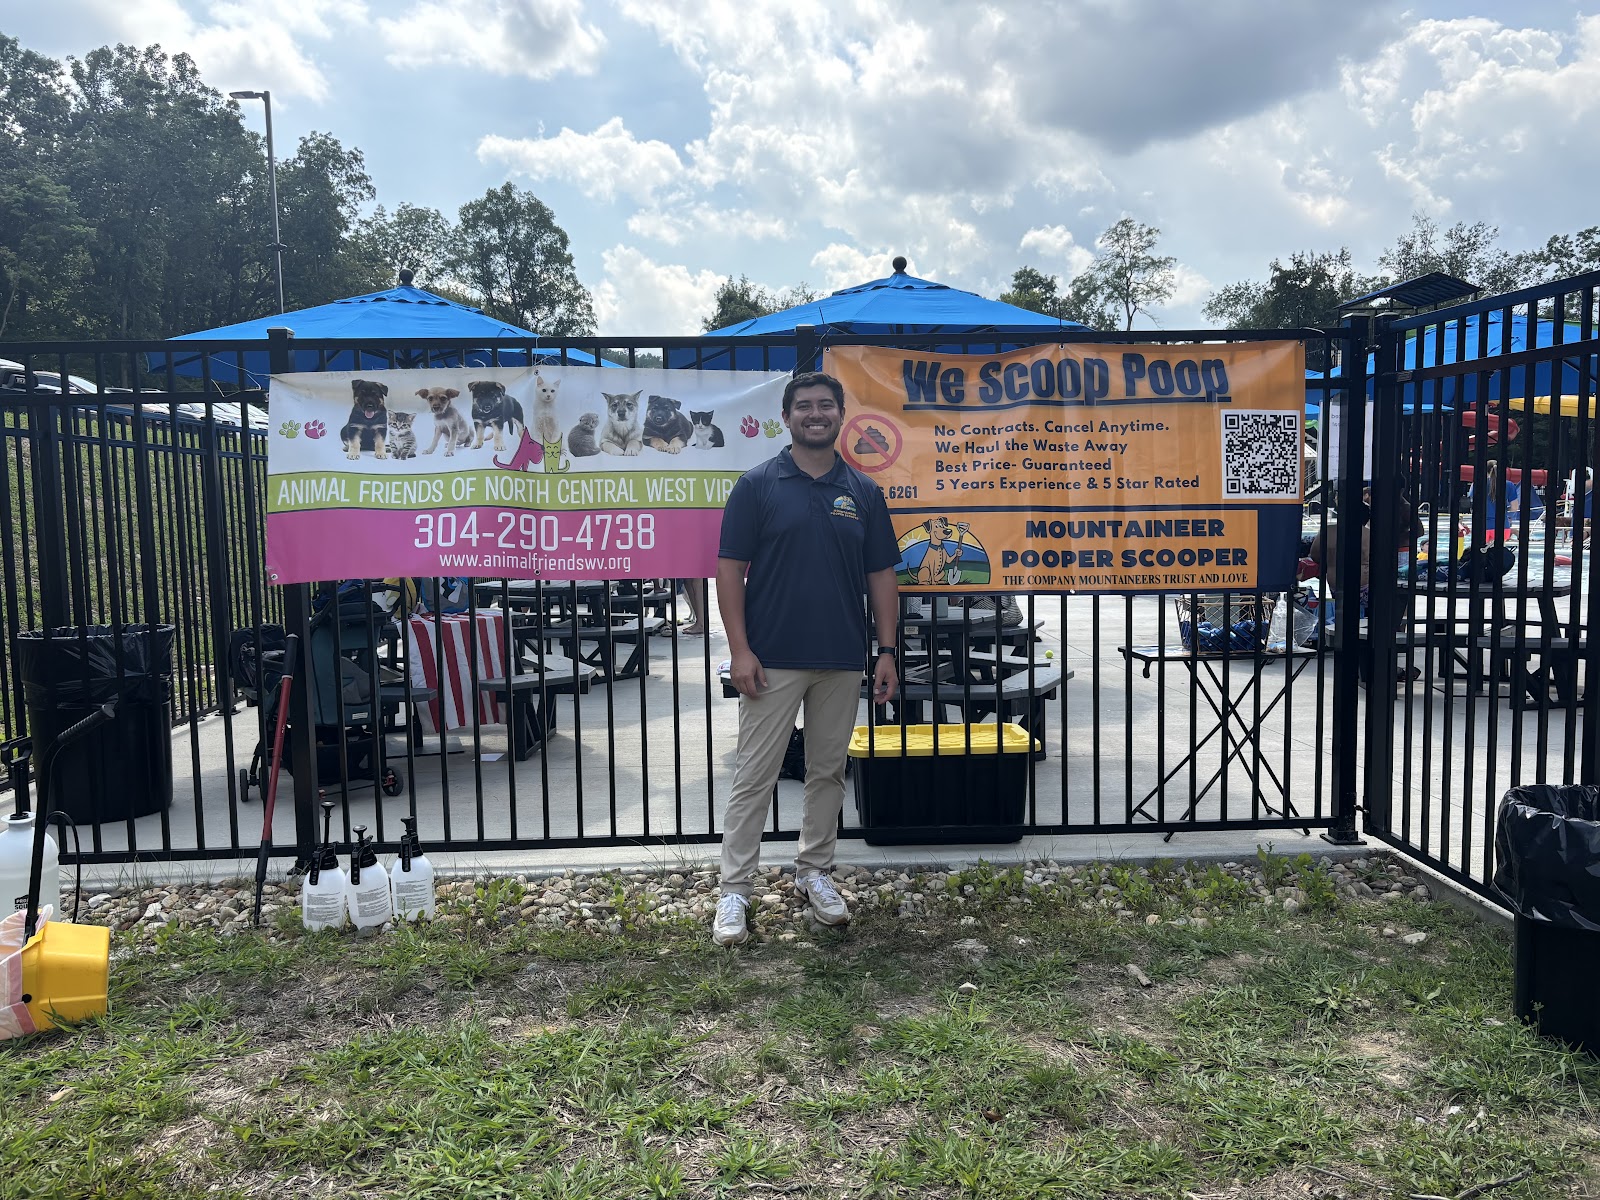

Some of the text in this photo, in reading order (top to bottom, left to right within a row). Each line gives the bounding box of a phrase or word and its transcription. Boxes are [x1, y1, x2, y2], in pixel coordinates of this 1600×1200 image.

[903, 353, 1230, 406] We Scoop Poop
[934, 420, 1170, 437] No Contracts. Cancel Anytime.
[935, 439, 1128, 455] We Haul the Waste Away
[935, 458, 1112, 473] Best Price- Guaranteed
[277, 476, 738, 506] ANIMAL FRIENDS OF NORTH CENTRAL WEST VIR
[935, 475, 1200, 492] 5 Years Experience & 5 Star Rated
[414, 511, 655, 551] 304-290-4738
[1026, 519, 1225, 539] MOUNTAINEER
[439, 551, 631, 573] www.animalfriendswv.org
[1001, 548, 1248, 568] POOPER SCOOPER
[1002, 573, 1248, 586] THE COMPANY MOUNTAINEERS TRUST AND LOVE
